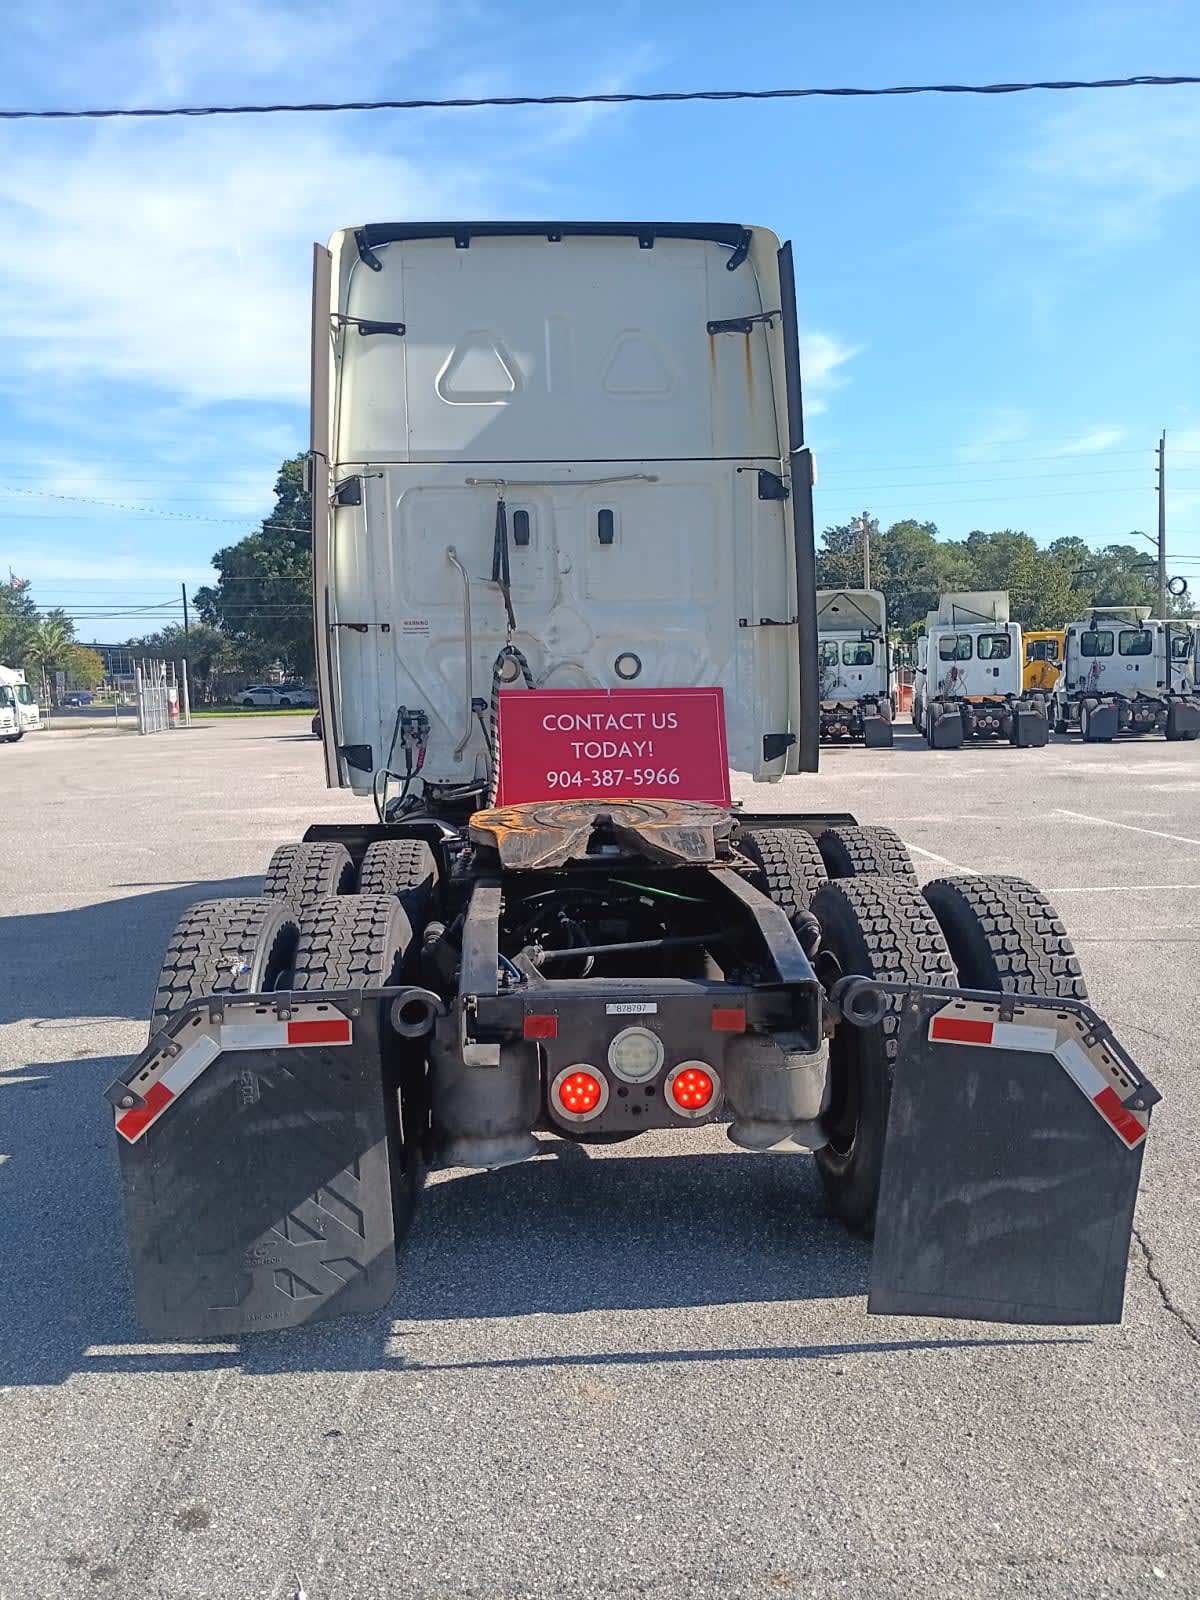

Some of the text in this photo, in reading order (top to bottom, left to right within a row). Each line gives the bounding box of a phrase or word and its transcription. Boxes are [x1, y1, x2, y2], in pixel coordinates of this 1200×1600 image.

[542, 712, 678, 731] CONTACT US
[571, 741, 654, 759] TODAY!
[546, 768, 680, 788] 904-387-5966
[616, 1004, 647, 1013] 878797
